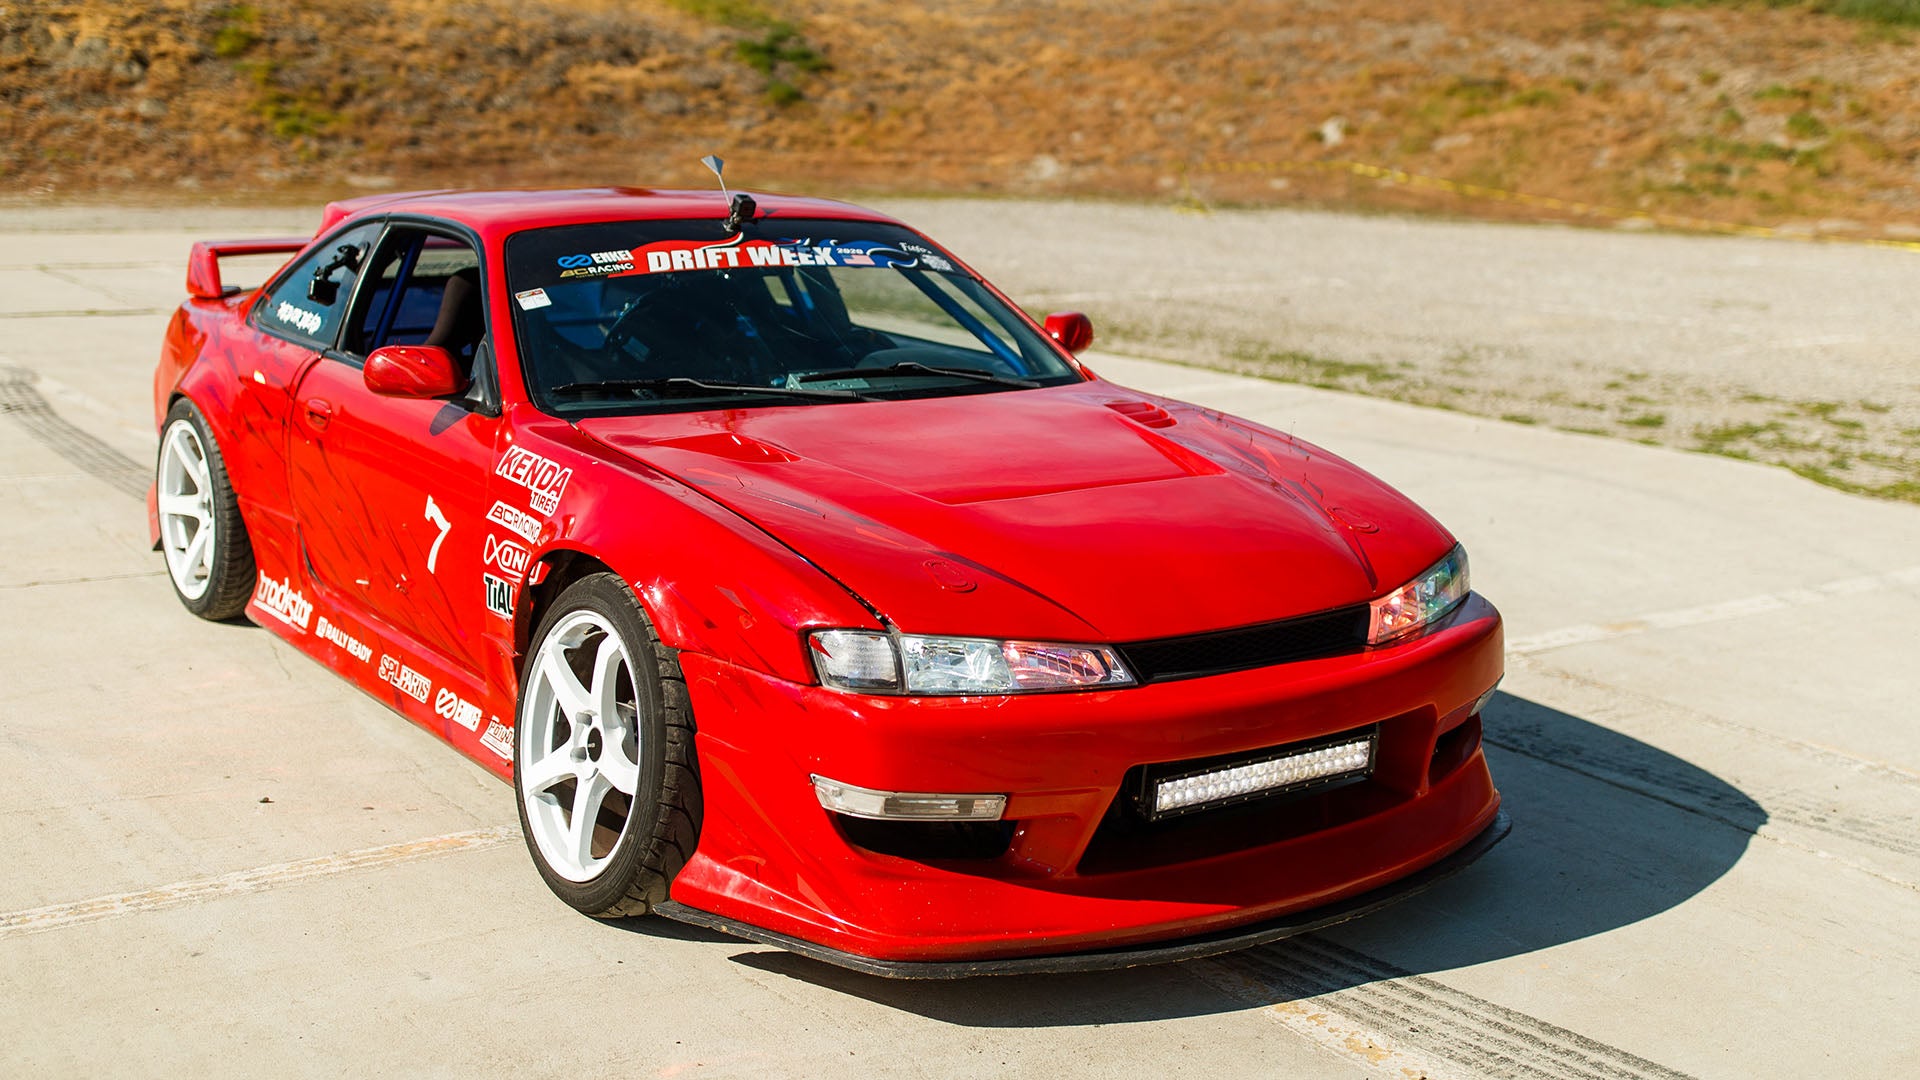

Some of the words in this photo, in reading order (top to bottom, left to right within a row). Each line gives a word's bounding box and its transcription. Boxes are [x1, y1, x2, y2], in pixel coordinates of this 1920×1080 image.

[590, 249, 634, 264] ENKEI
[647, 246, 740, 273] DRIFT
[746, 245, 837, 267] WEEK
[496, 445, 573, 499] KENDA
[530, 490, 558, 515] TIRES
[424, 494, 452, 575] 7
[325, 623, 349, 649] RALLY
[346, 636, 373, 663] READY
[401, 666, 431, 703] PARTS
